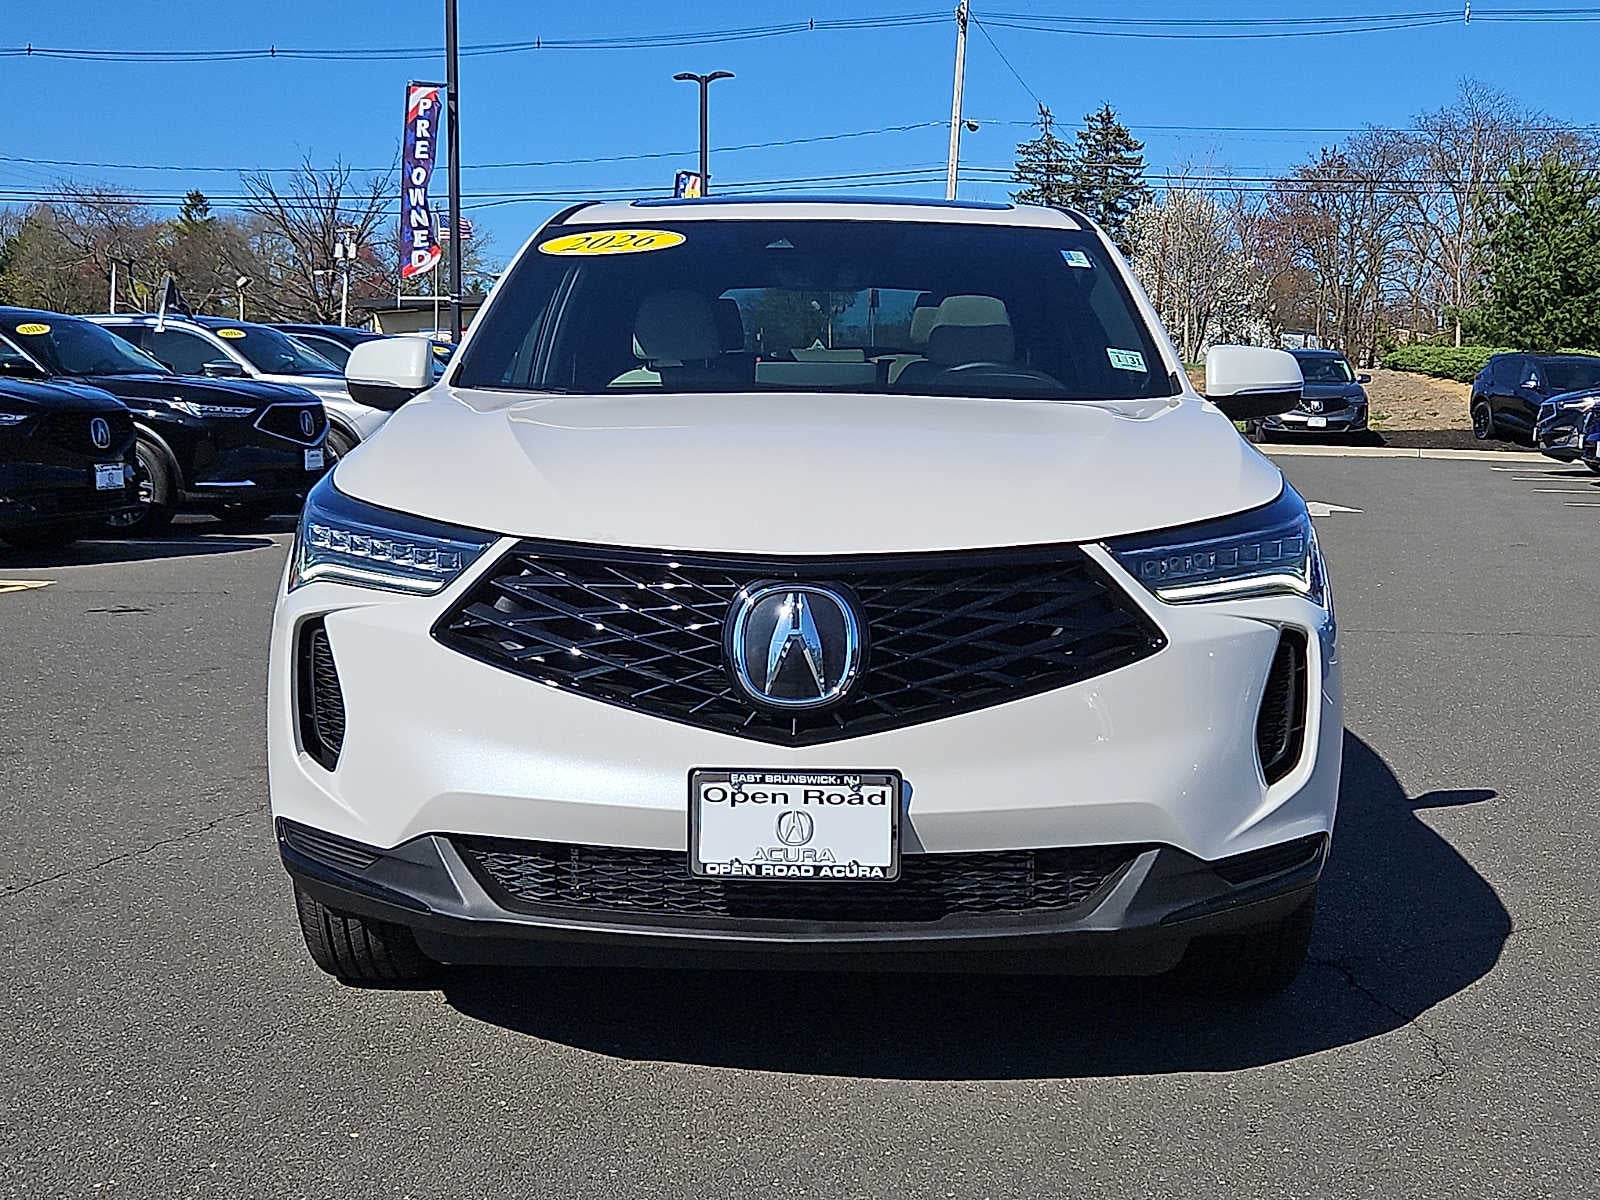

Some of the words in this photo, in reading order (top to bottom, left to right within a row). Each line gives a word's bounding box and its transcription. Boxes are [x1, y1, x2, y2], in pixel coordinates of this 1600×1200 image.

[414, 98, 432, 160] PRE
[409, 166, 431, 267] OWNED
[560, 233, 662, 252] 2026
[730, 774, 762, 784] EAST
[844, 775, 860, 785] NJ
[703, 787, 789, 807] Open
[803, 789, 886, 806] Road
[749, 847, 836, 863] ACURA
[705, 863, 756, 876] OPEN
[761, 865, 814, 878] ROAD
[819, 866, 884, 878] ACURA
